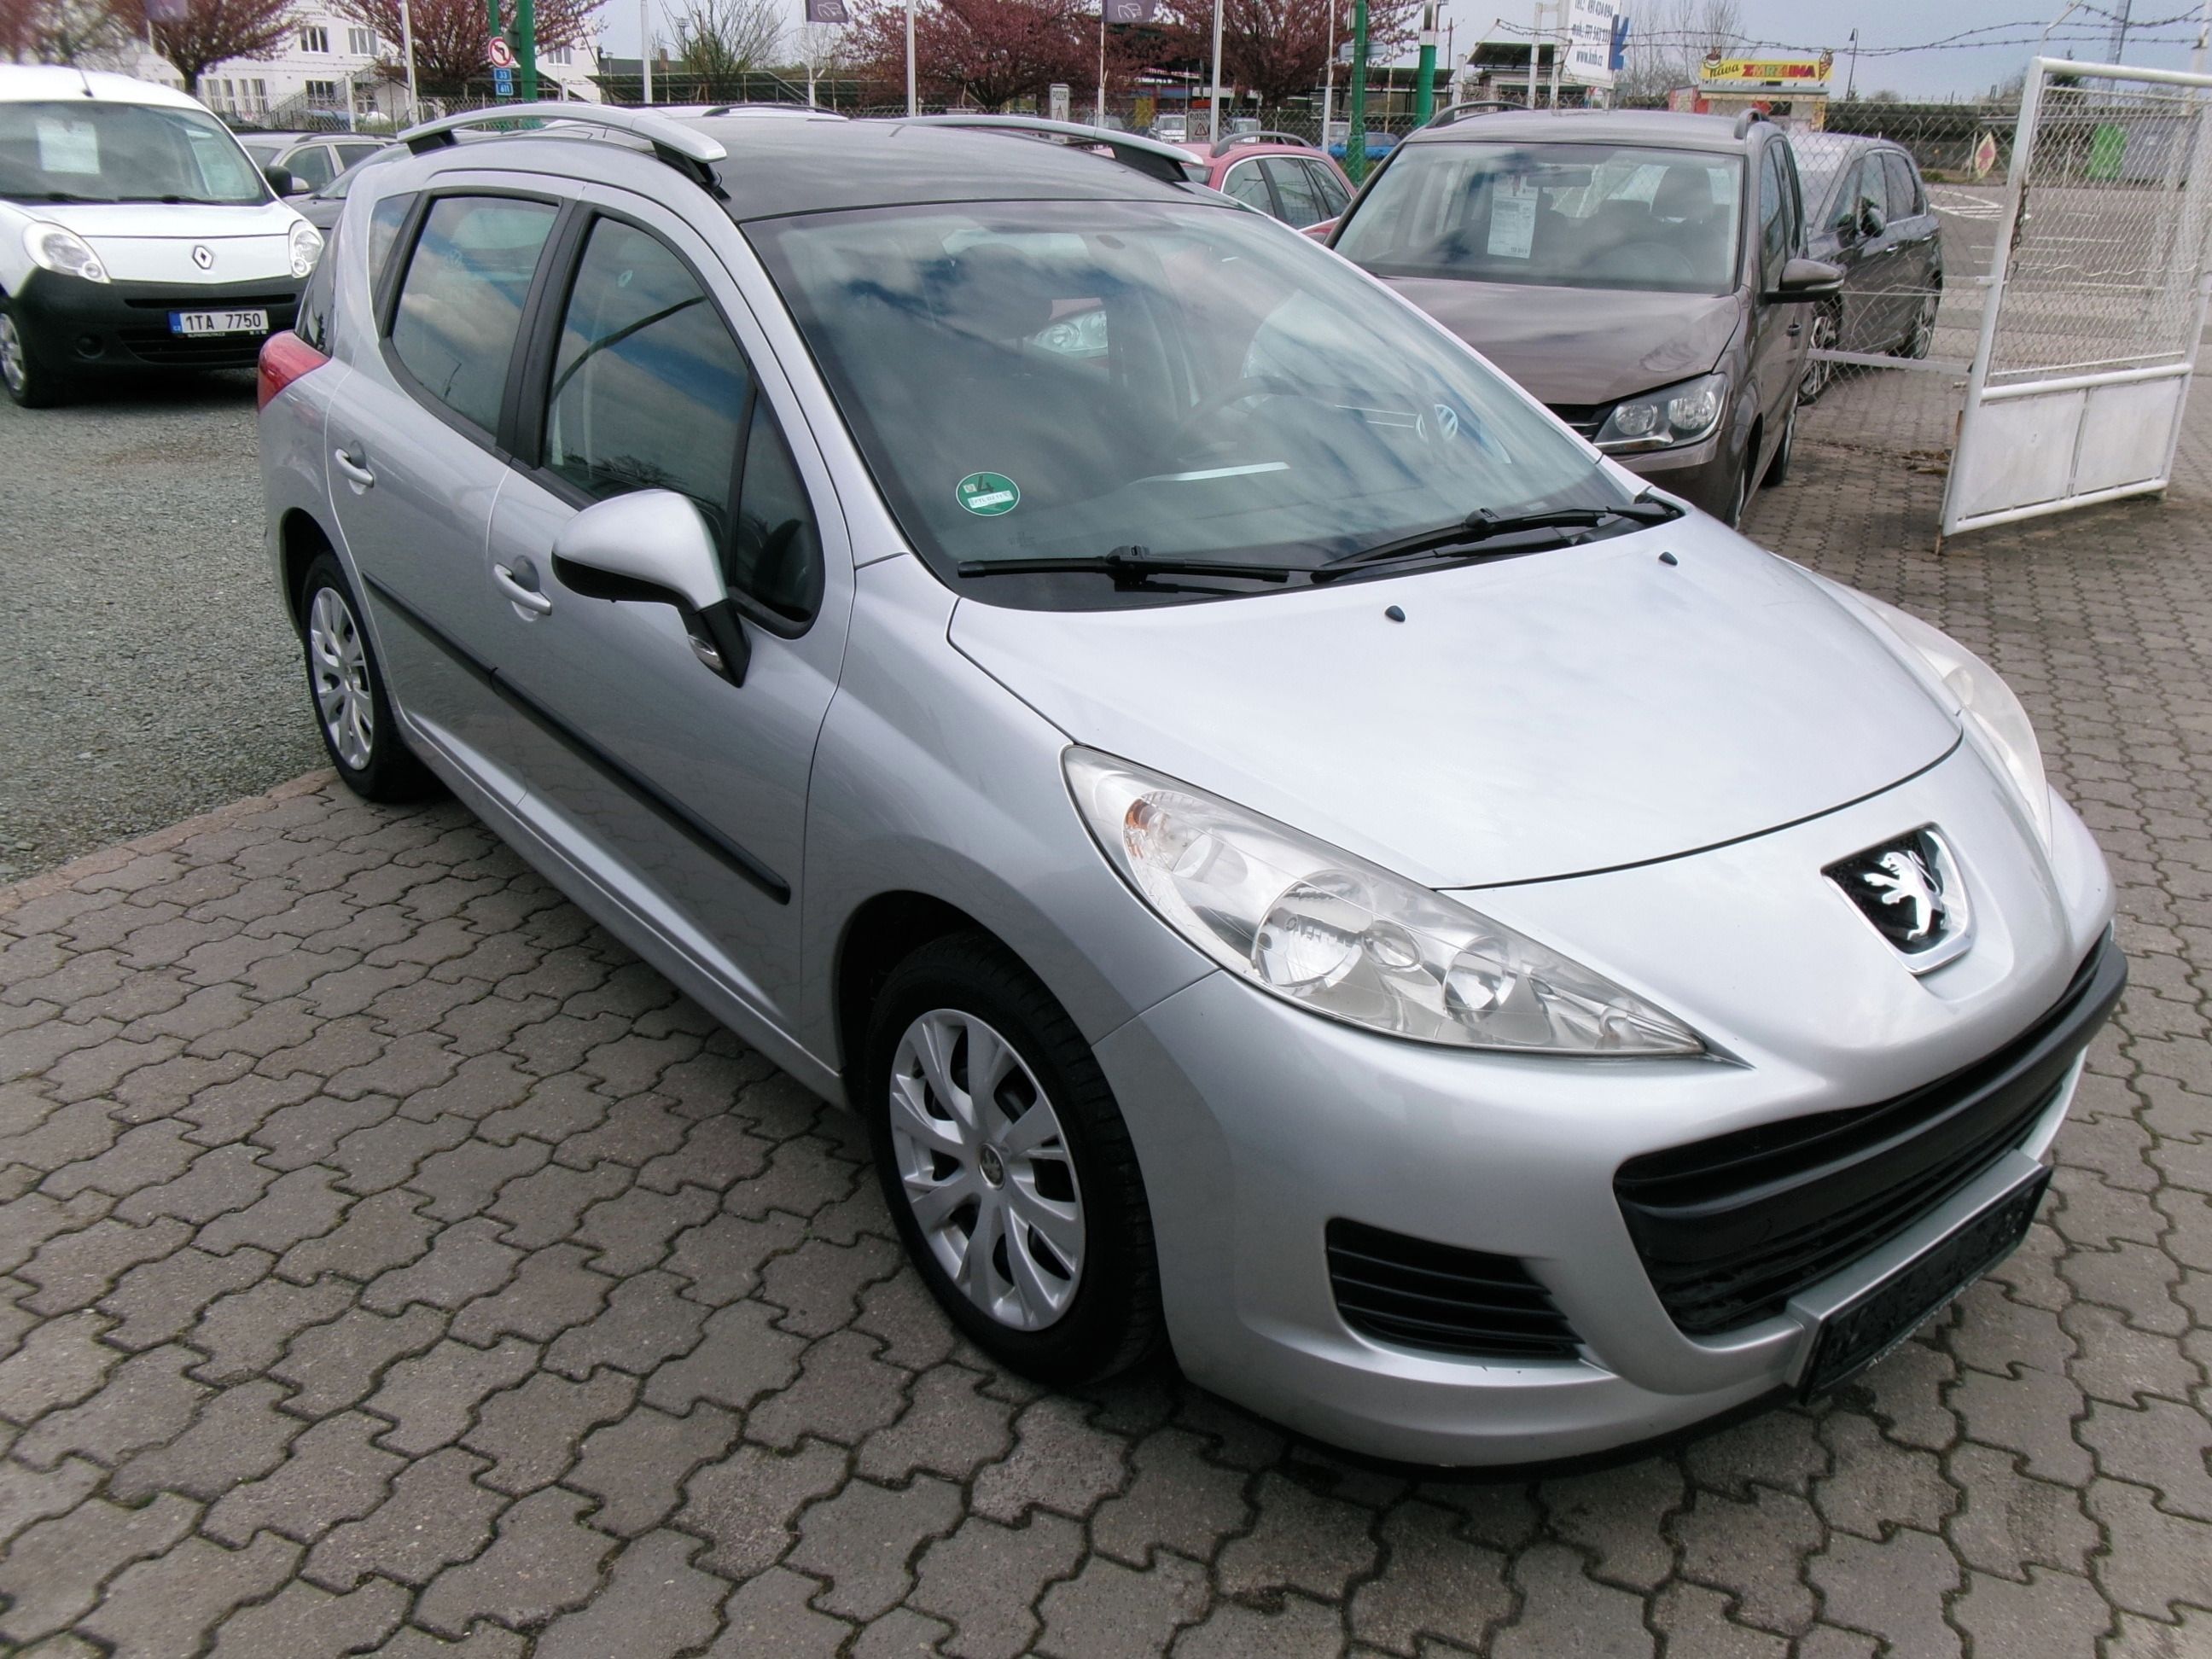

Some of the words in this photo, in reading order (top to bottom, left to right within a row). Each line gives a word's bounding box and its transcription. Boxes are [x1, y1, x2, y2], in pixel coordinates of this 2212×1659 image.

[498, 70, 508, 79] 33
[1742, 64, 1816, 78] ZMRZLINA
[186, 315, 215, 331] 1TA
[225, 312, 261, 329] 7750
[977, 475, 994, 492] 4
